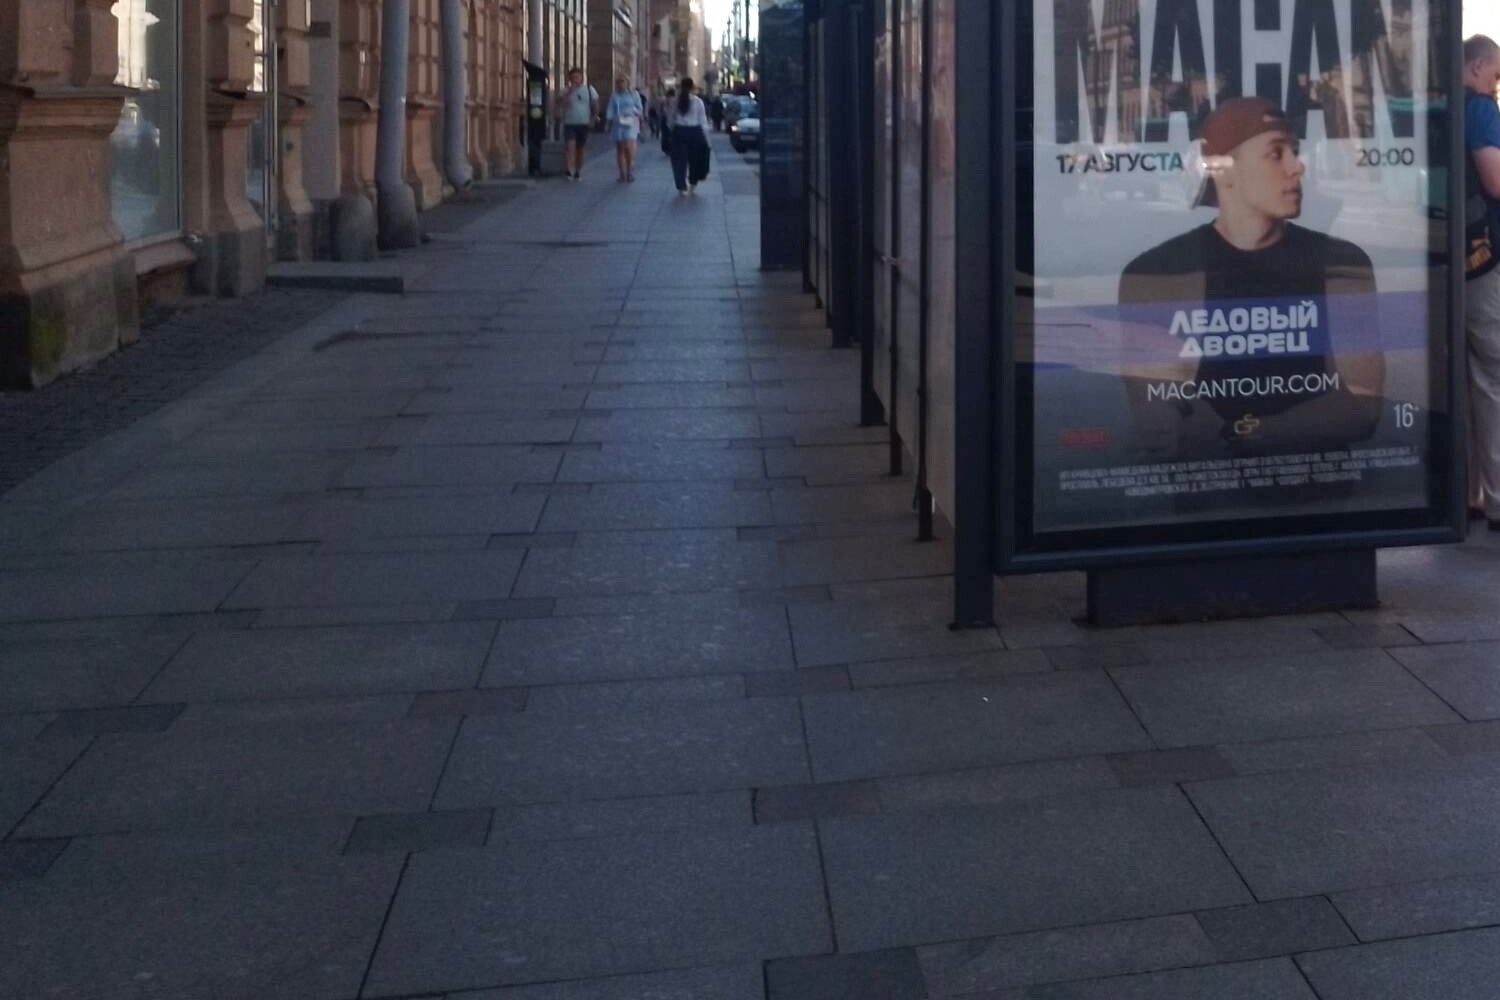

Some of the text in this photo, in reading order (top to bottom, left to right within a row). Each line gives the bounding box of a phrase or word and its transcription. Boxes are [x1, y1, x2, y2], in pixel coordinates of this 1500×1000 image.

[1056, 153, 1076, 174] 17
[1356, 147, 1414, 167] 20:00
[1169, 300, 1318, 335] ЛЕДОВЫЙ
[1178, 331, 1310, 358] ДВОРЕЦ
[1147, 372, 1339, 402] MACANTOUR.COM
